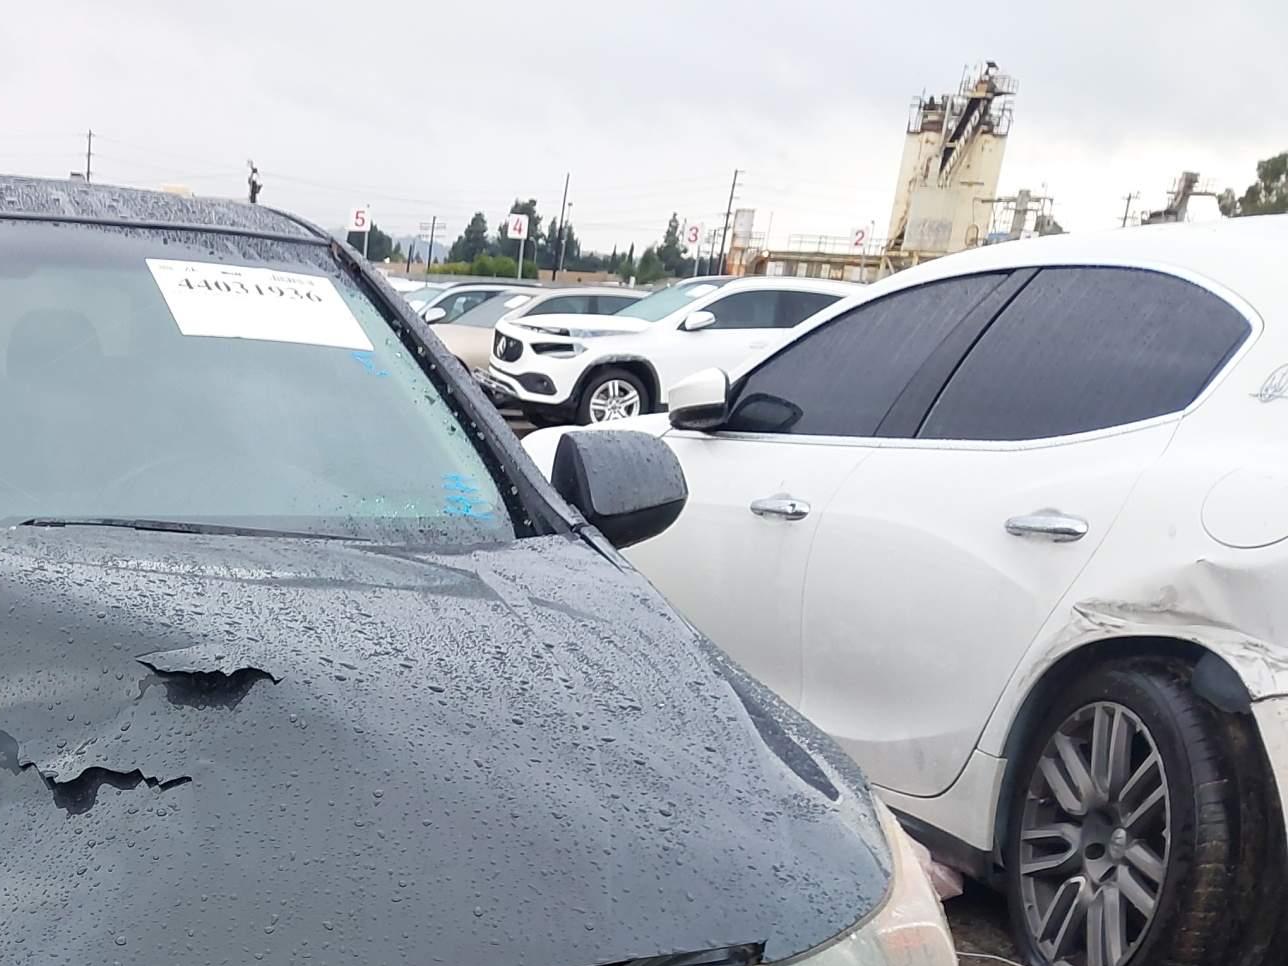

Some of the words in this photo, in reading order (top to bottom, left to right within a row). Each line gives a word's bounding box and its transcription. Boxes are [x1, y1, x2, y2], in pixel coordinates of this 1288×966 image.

[354, 210, 365, 226] 5
[512, 216, 523, 235] 4
[688, 227, 699, 243] 3
[854, 231, 865, 247] 2
